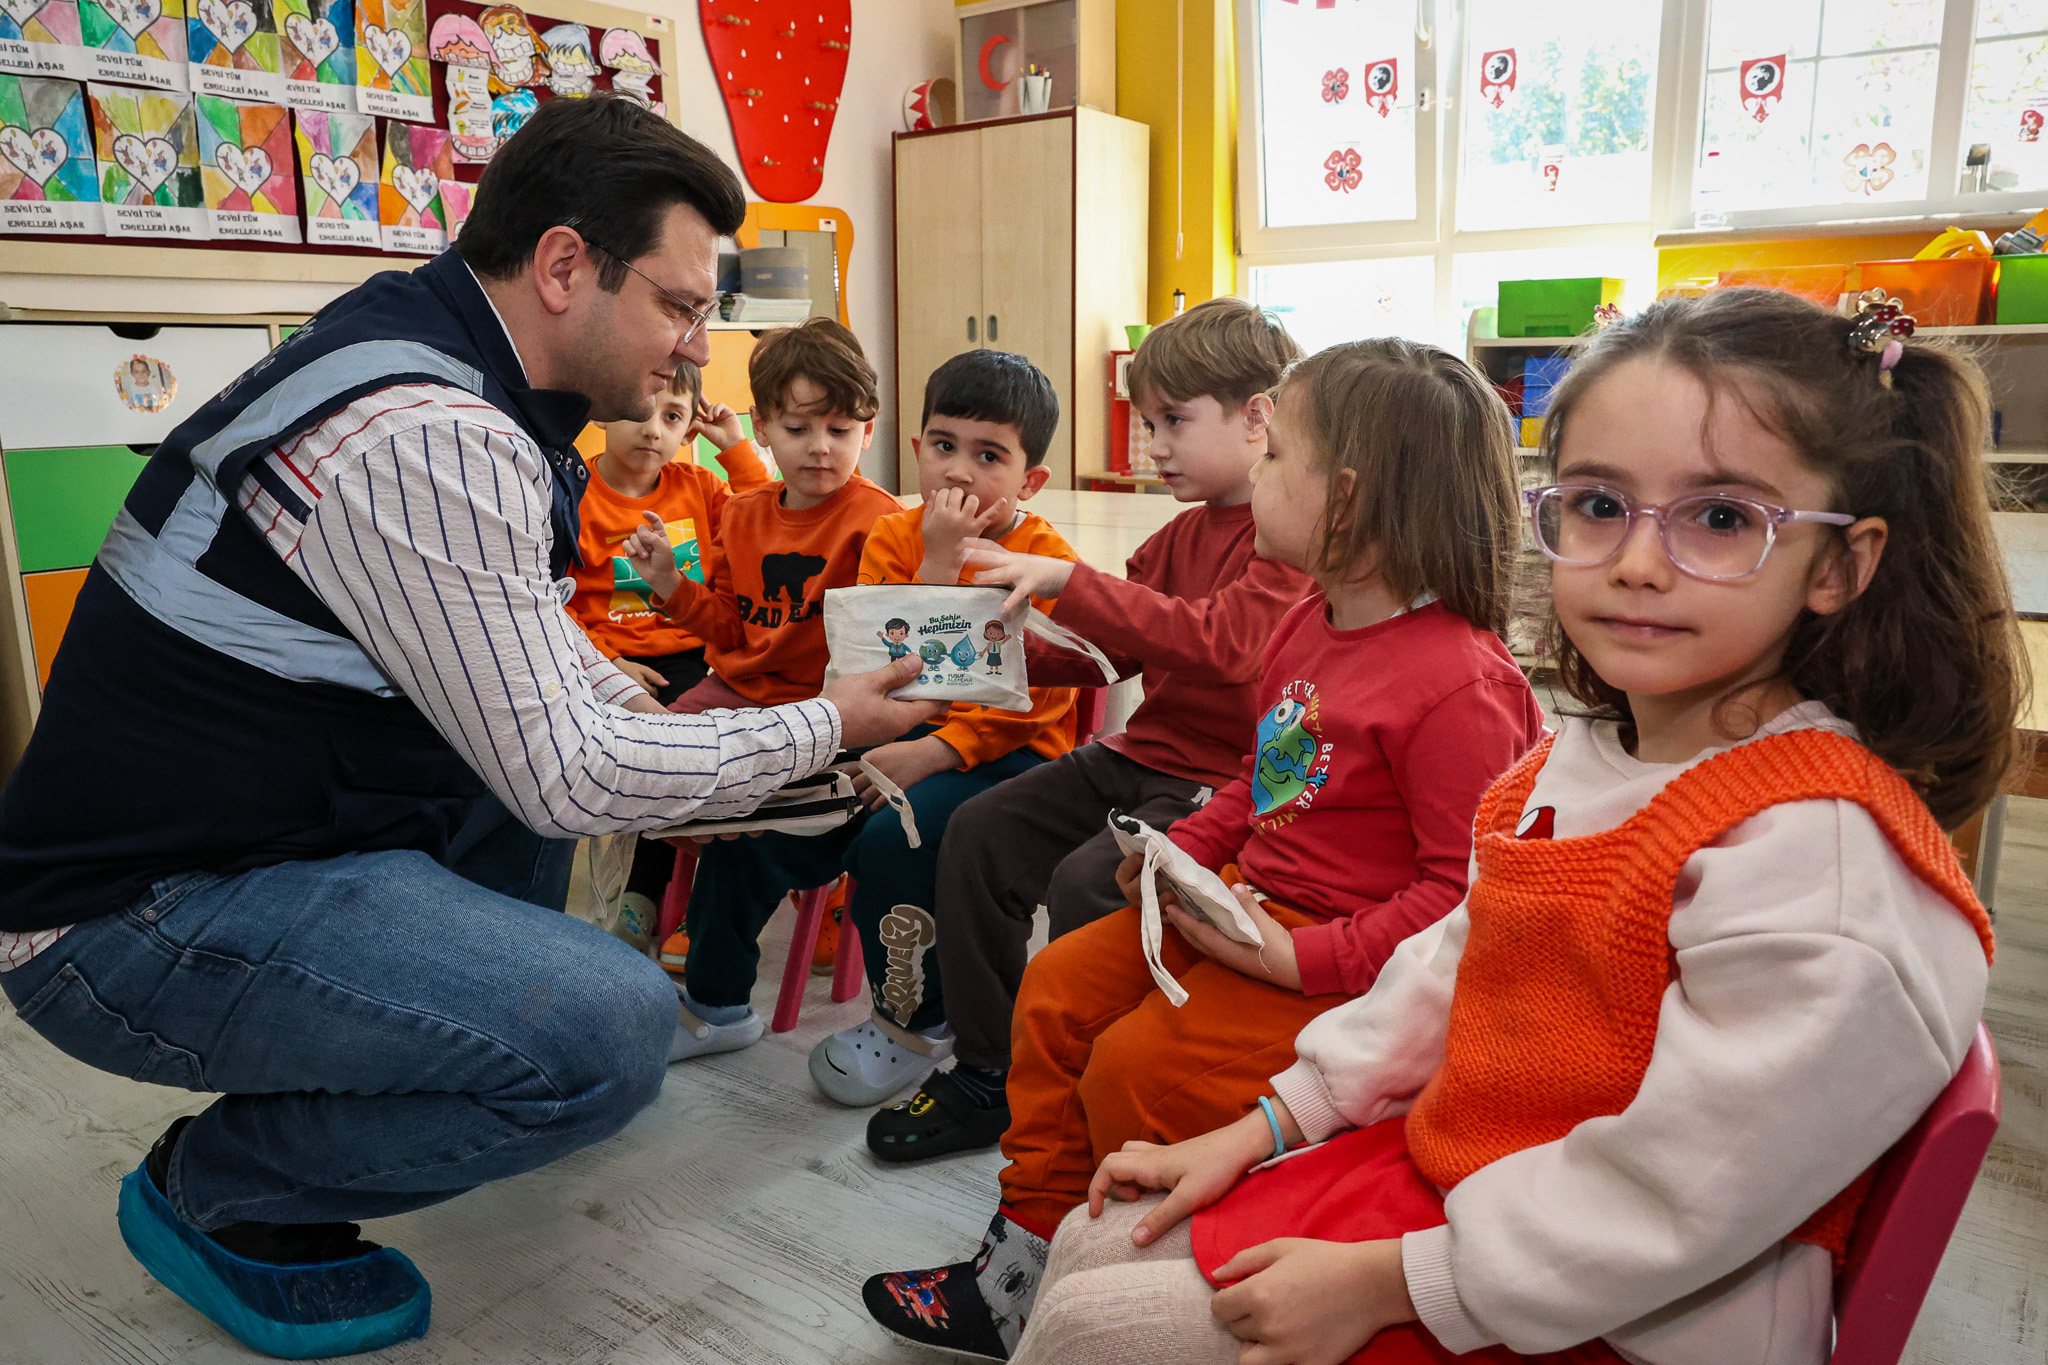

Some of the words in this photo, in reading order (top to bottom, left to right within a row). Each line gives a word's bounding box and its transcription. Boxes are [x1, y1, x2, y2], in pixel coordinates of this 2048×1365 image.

[9, 44, 30, 54] TÜM
[95, 54, 122, 65] SEVGİ
[124, 57, 143, 67] TÜM
[37, 62, 65, 71] AŞAR
[98, 69, 147, 81] ENGELLERİ
[149, 75, 172, 86] AŞAR
[200, 68, 224, 78] SEVGİ
[225, 72, 241, 80] TÜM
[203, 82, 245, 94] ENGELLERİ
[247, 88, 269, 97] AŞAR
[307, 86, 321, 94] TÜM
[326, 101, 346, 110] AŞAR
[4, 204, 33, 213] SEVGİ
[34, 204, 52, 213] TÜM
[116, 209, 143, 218] SEVGİ
[144, 209, 162, 218] TÜM
[216, 213, 241, 222] SEVGİ
[242, 214, 258, 222] TÜM
[7, 219, 57, 229] ENGELLERİ
[60, 221, 85, 230] AŞAR
[120, 223, 167, 232] ENGELLERİ
[169, 224, 192, 233] AŞAR
[218, 227, 262, 236] ENGELLERİ
[263, 229, 283, 237] AŞAR
[737, 594, 782, 628] BAD
[929, 617, 939, 625] Bu
[918, 619, 972, 636] Hepimizin
